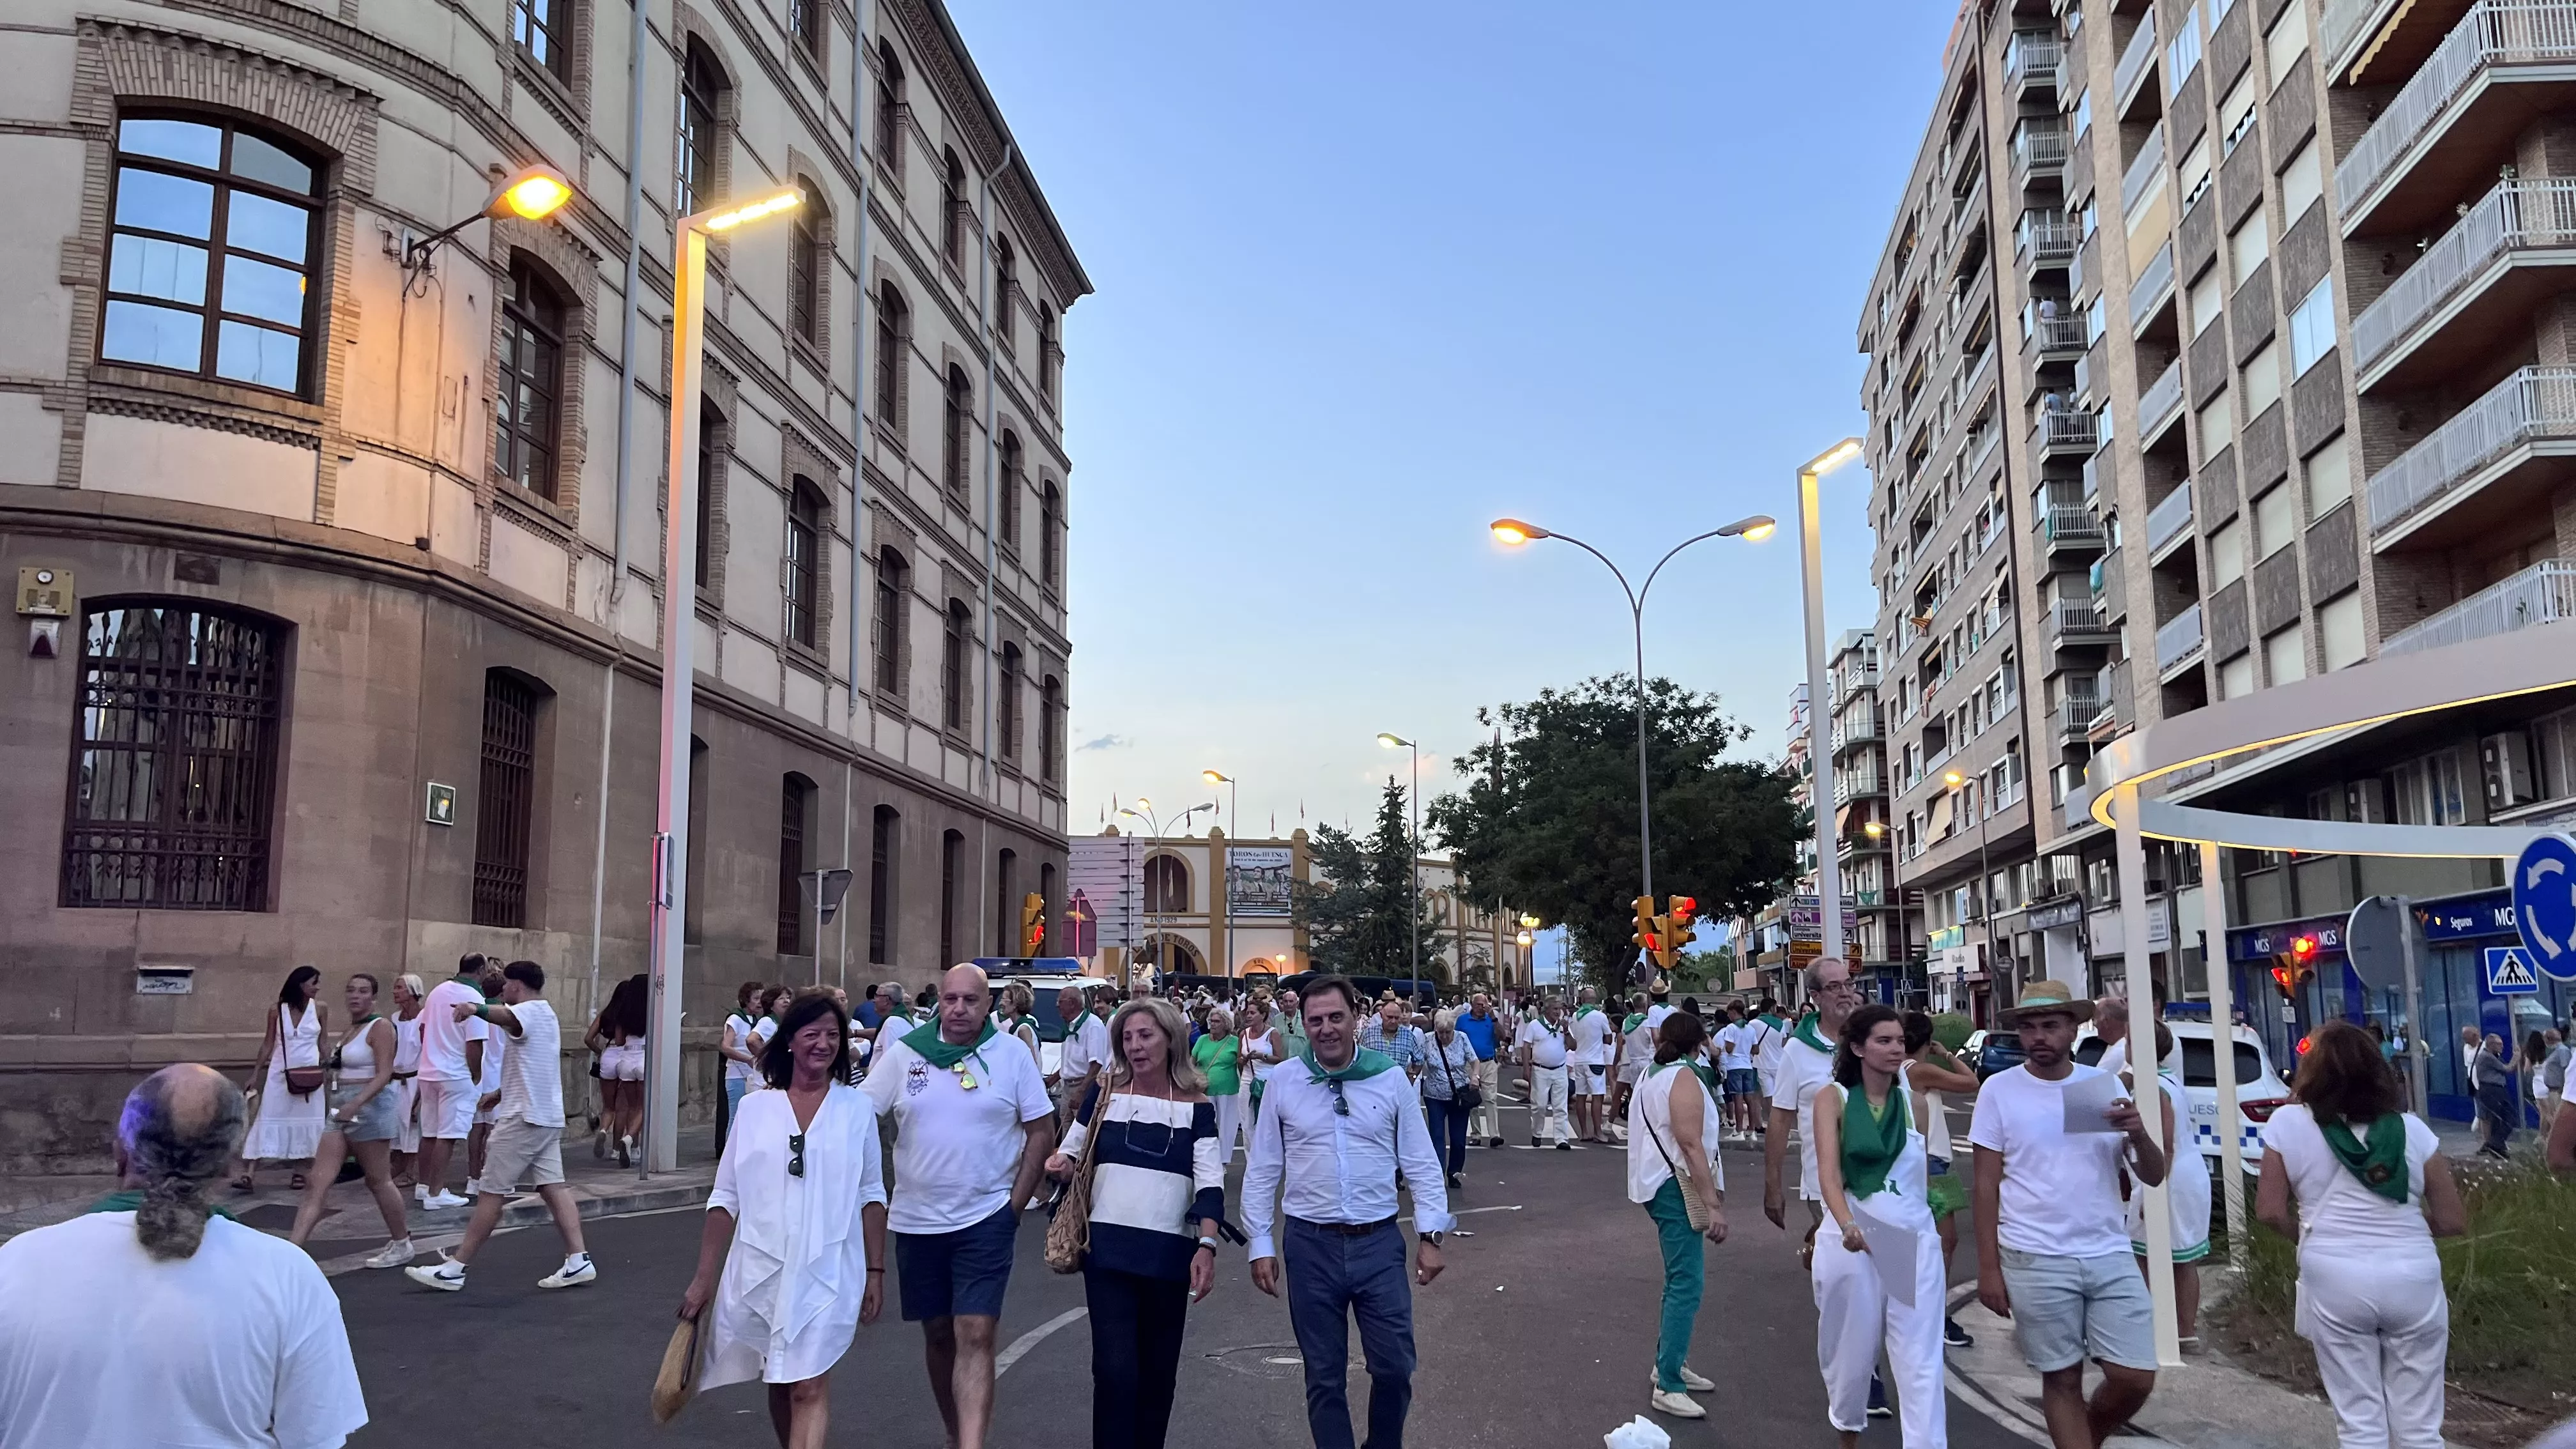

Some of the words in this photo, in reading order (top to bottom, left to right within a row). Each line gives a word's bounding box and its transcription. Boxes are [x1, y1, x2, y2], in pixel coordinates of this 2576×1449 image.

[2450, 916, 2472, 931] Seguros
[2494, 907, 2515, 926] MG
[1174, 935, 1199, 956] TOROS
[2255, 938, 2269, 953] MGS
[2318, 930, 2336, 946] MGS
